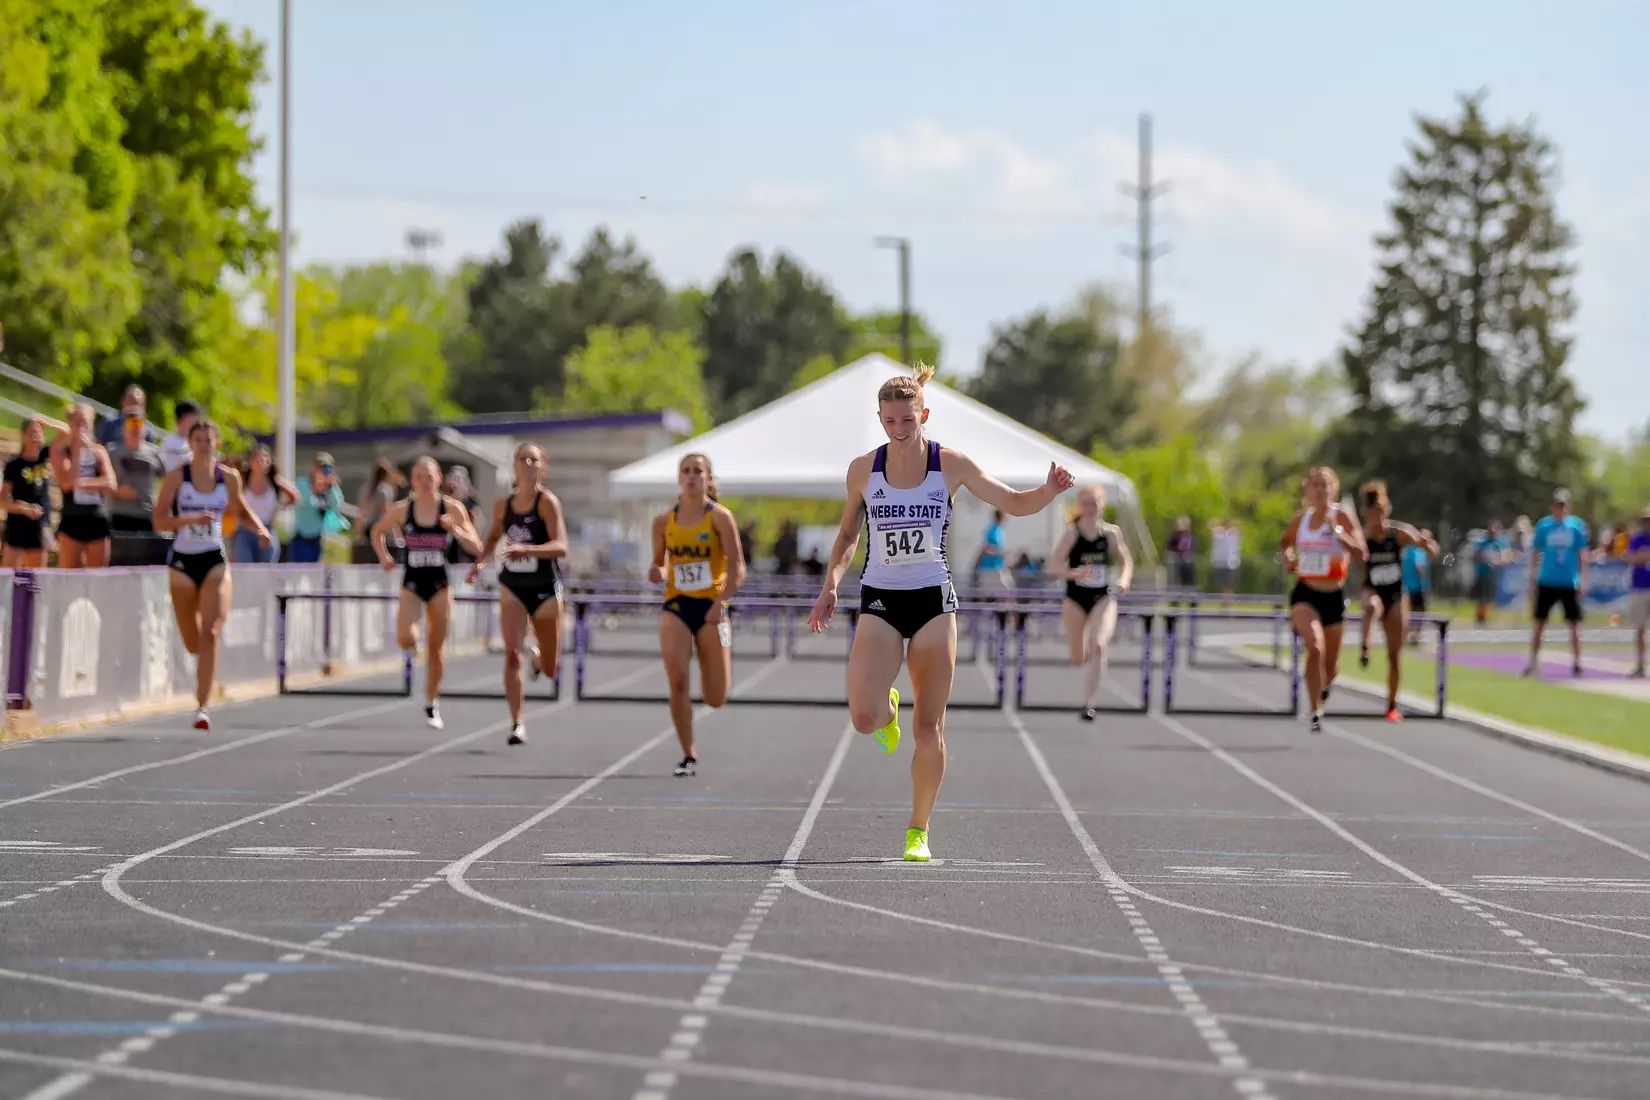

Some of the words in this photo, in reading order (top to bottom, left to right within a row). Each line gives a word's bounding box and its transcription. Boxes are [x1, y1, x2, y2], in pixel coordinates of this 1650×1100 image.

[871, 505, 905, 519] WEBER
[909, 505, 941, 519] STATE
[885, 530, 926, 557] 542
